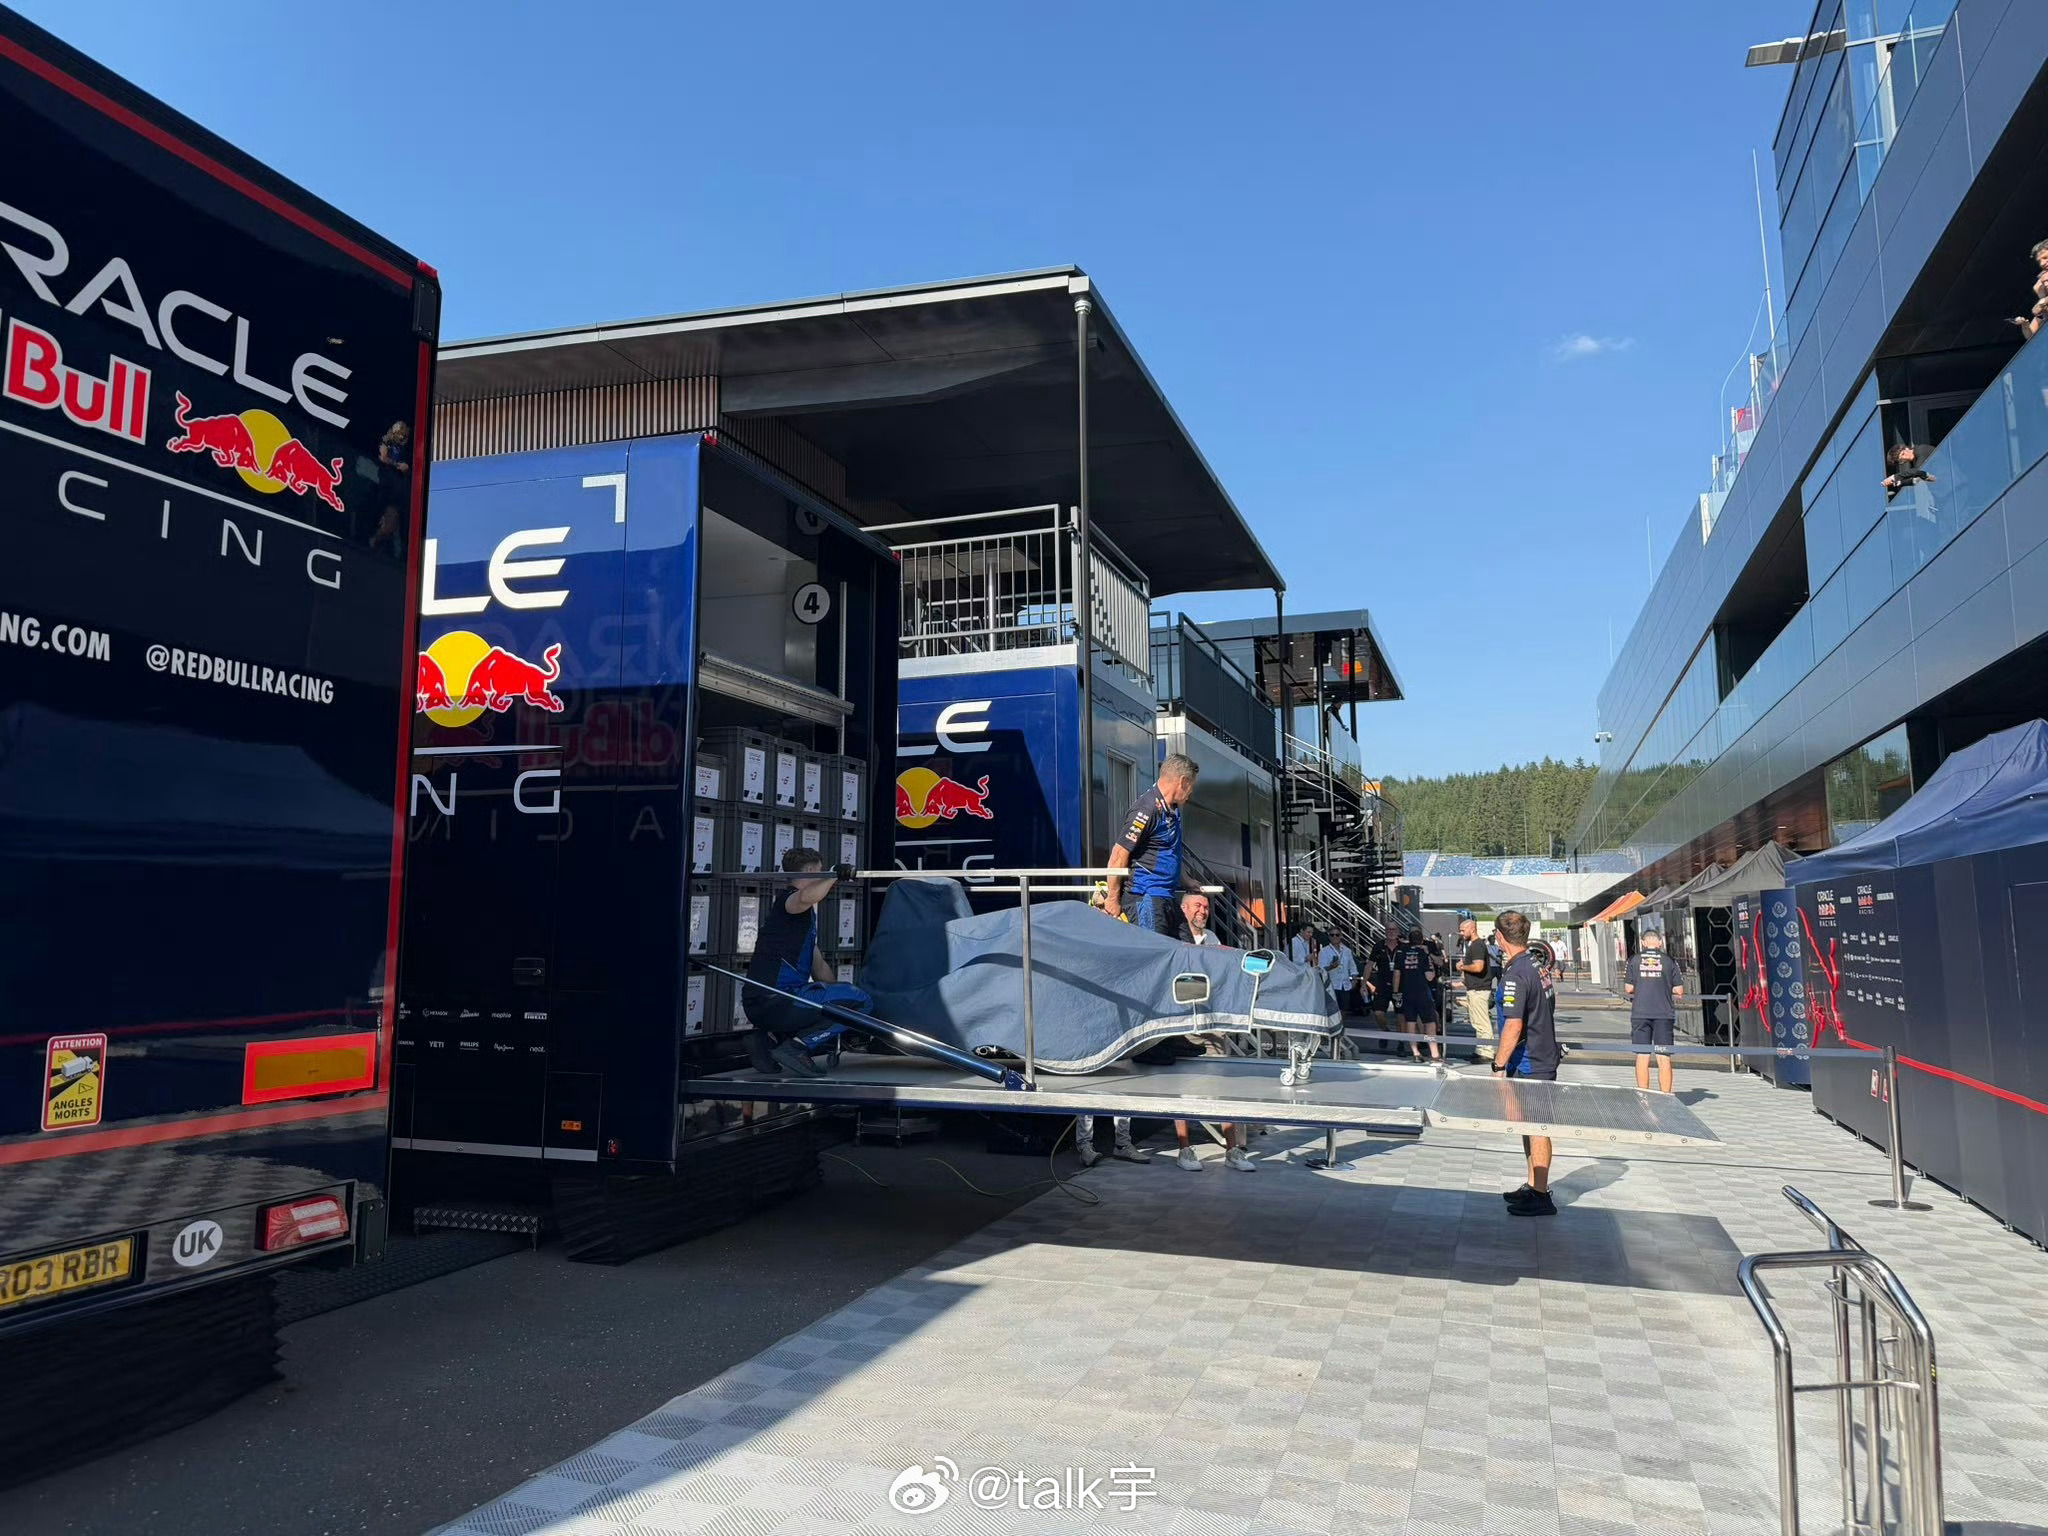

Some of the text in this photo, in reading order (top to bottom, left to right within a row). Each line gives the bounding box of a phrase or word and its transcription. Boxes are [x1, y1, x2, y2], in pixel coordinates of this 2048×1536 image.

[3, 316, 152, 445] Bull
[421, 526, 571, 616] LE
[803, 592, 820, 614] 4
[0, 611, 334, 704] NG.COM @REDBULLRACING
[411, 769, 561, 817] NG
[53, 1038, 103, 1049] ATTENTION
[429, 1040, 445, 1049] YETI
[459, 1040, 480, 1048] PHILIPS
[53, 1098, 93, 1110] ANGLES
[55, 1108, 91, 1120] MORTS
[179, 1226, 217, 1258] UK
[61, 1244, 121, 1285] RBR
